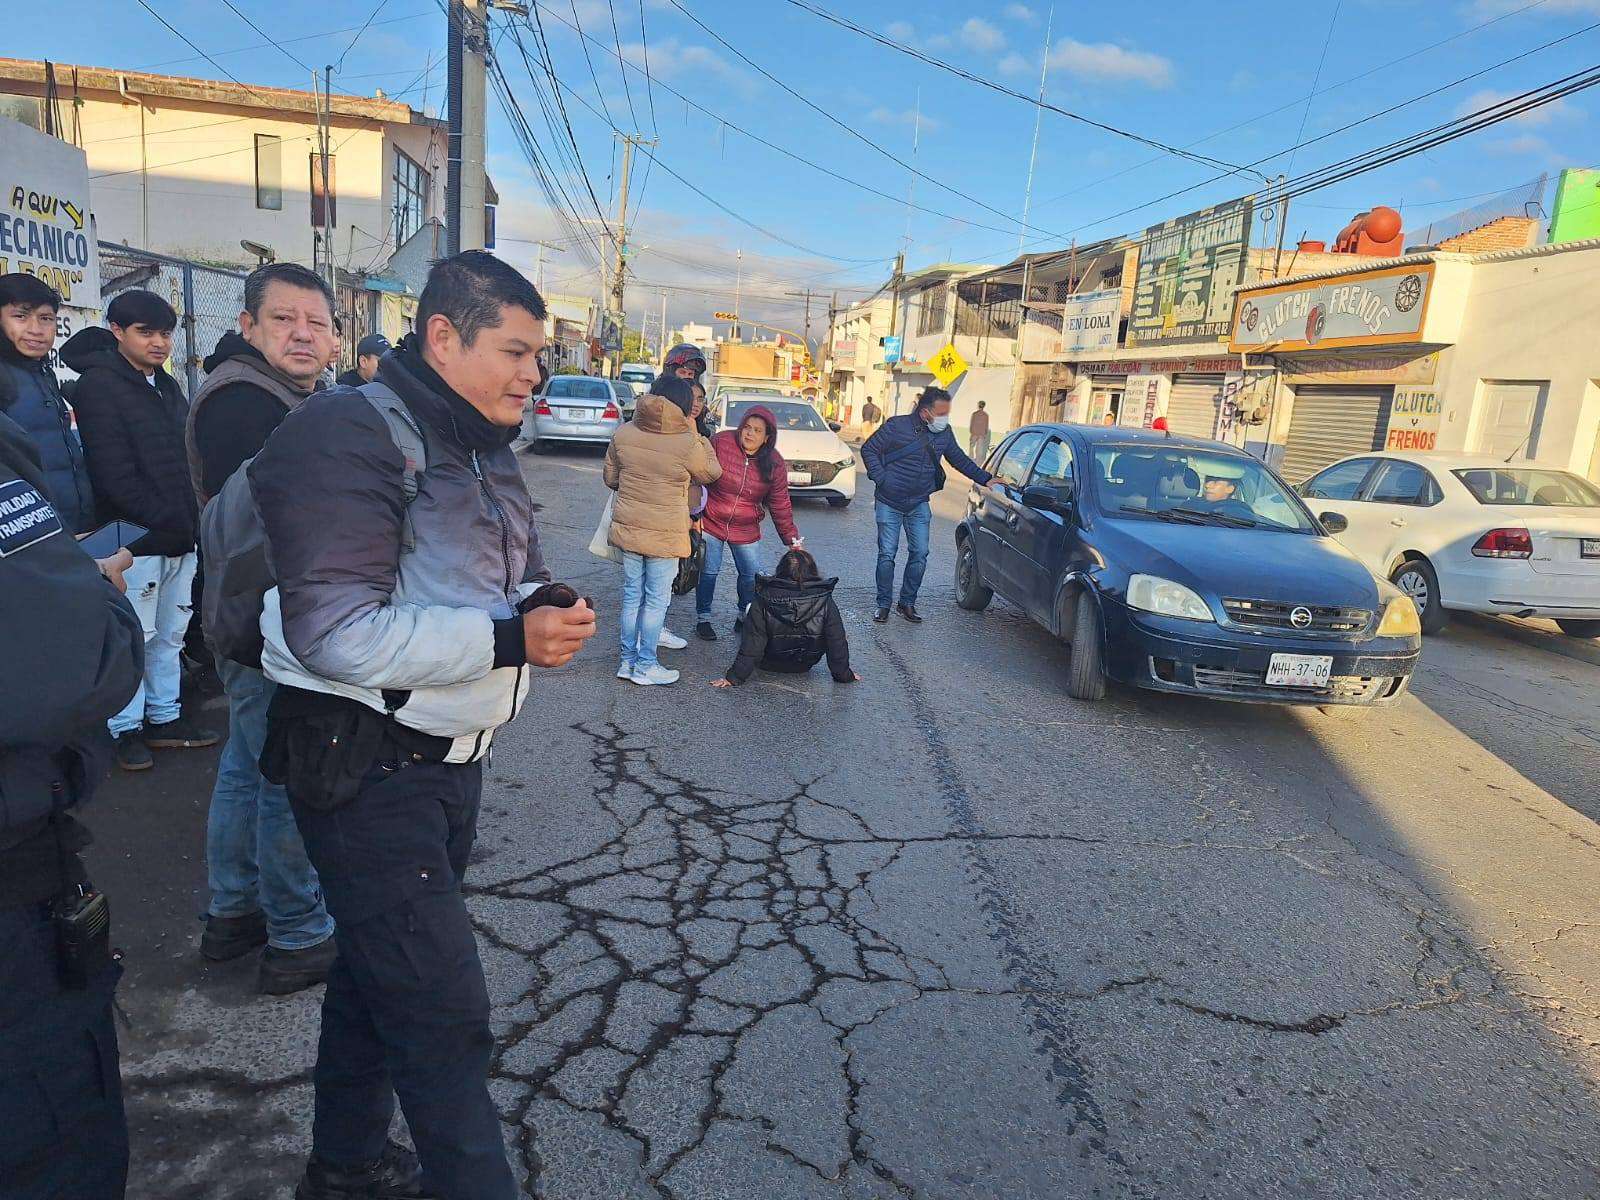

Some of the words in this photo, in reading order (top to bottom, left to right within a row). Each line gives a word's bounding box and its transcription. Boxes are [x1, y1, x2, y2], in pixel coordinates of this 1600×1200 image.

[12, 186, 58, 216] AQUI
[1069, 318, 1082, 330] EN
[1084, 315, 1110, 329] LONA
[1258, 292, 1311, 342] CLUTCH
[1329, 285, 1392, 335] FRENOS
[1080, 362, 1106, 374] OSMAR
[1150, 360, 1187, 372] ALUMINIO
[1194, 358, 1243, 371] HERRERIA
[1387, 429, 1436, 450] FRENOS
[0, 492, 36, 518] VILIDAD
[0, 506, 55, 539] TRANSPORTE
[1270, 662, 1328, 677] NHH-37-06
